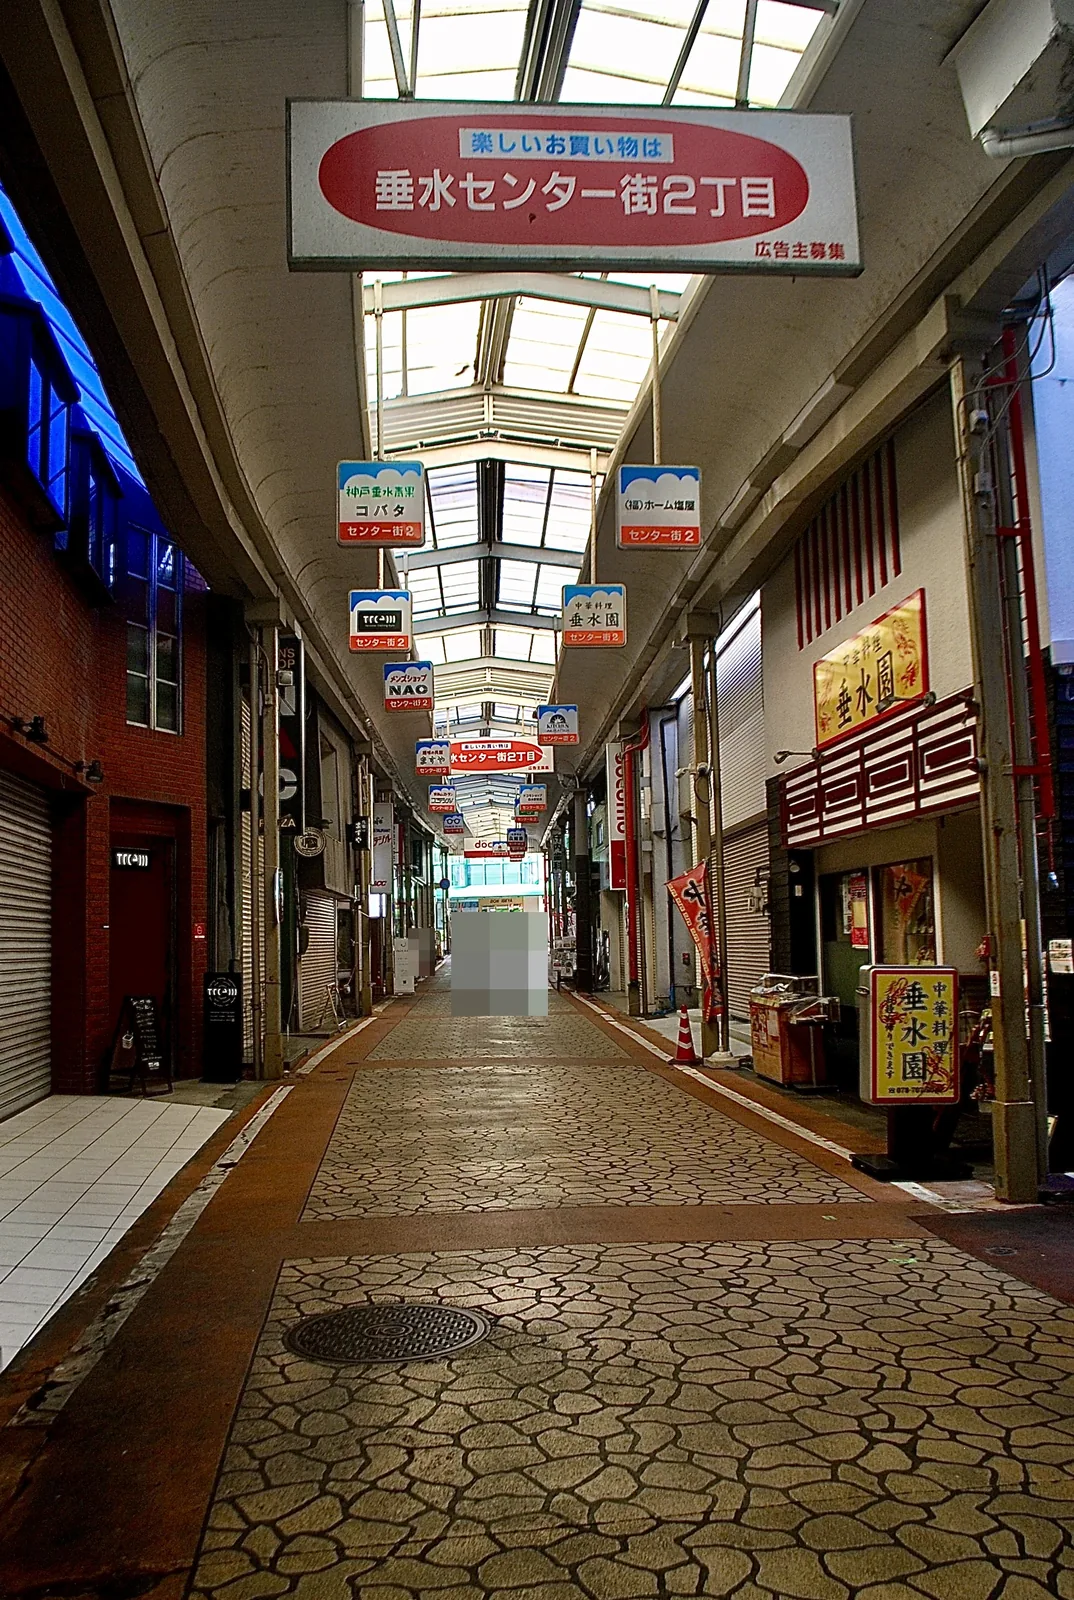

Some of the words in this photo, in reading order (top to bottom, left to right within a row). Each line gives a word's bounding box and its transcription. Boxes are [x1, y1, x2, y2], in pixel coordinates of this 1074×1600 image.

[471, 132, 662, 158] 楽しいお買い物は
[375, 168, 777, 219] 垂水センター街2丁目
[754, 240, 845, 260] 広告主募集
[356, 504, 405, 517] コバタ
[347, 525, 415, 537] センター街2
[629, 529, 695, 542] センター街2
[575, 601, 613, 610] 中華料理
[569, 612, 619, 627] 垂水園
[356, 638, 405, 647] センター街2
[570, 632, 619, 642] センター街2
[390, 674, 427, 683] メンズショップ
[389, 684, 428, 696] NAC
[836, 650, 894, 729] 垂水園
[420, 755, 446, 765] ますや
[450, 751, 535, 763] 水センター街2丁目
[475, 840, 493, 848] doc
[932, 981, 949, 1056] 中華料理
[901, 981, 929, 1082] 垂水園
